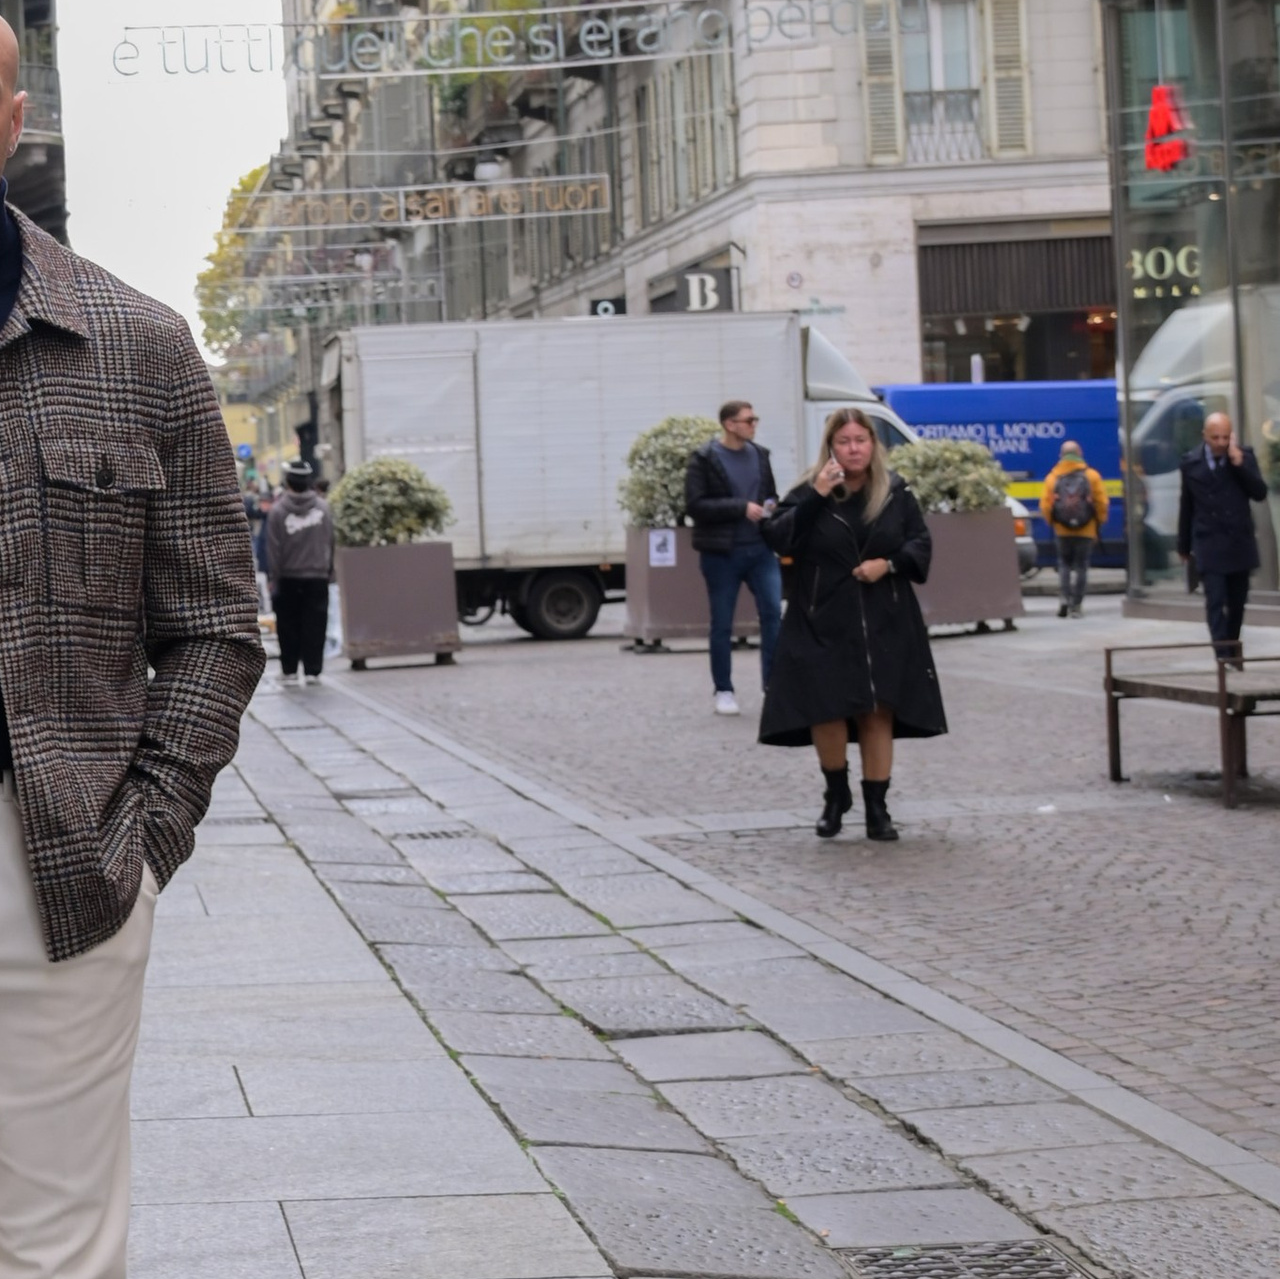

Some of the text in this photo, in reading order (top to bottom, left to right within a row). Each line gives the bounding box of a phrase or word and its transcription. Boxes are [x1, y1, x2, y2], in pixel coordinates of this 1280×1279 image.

[112, 40, 139, 76] e
[157, 26, 273, 74] tutti
[423, 17, 515, 67] che
[528, 13, 565, 62] si
[1003, 422, 1065, 439] MONDO
